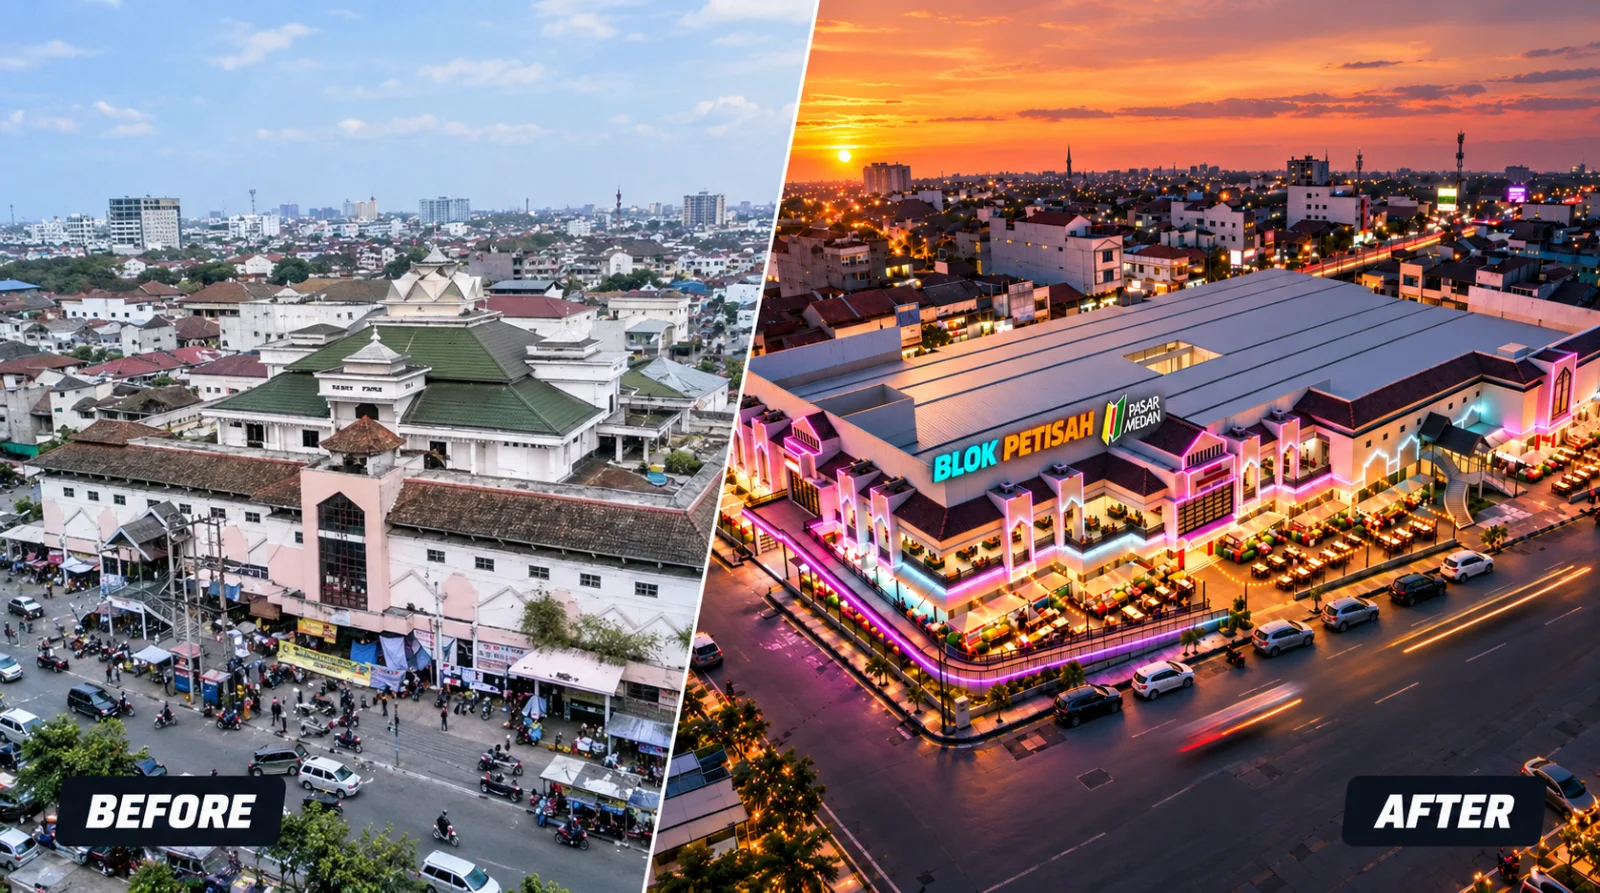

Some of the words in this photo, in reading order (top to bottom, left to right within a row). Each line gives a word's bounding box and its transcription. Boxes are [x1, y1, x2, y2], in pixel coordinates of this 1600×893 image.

[1129, 395, 1160, 417] PASAR
[1124, 409, 1161, 433] MEDAN
[933, 439, 998, 483] BLOK
[1003, 410, 1095, 462] PETISAH
